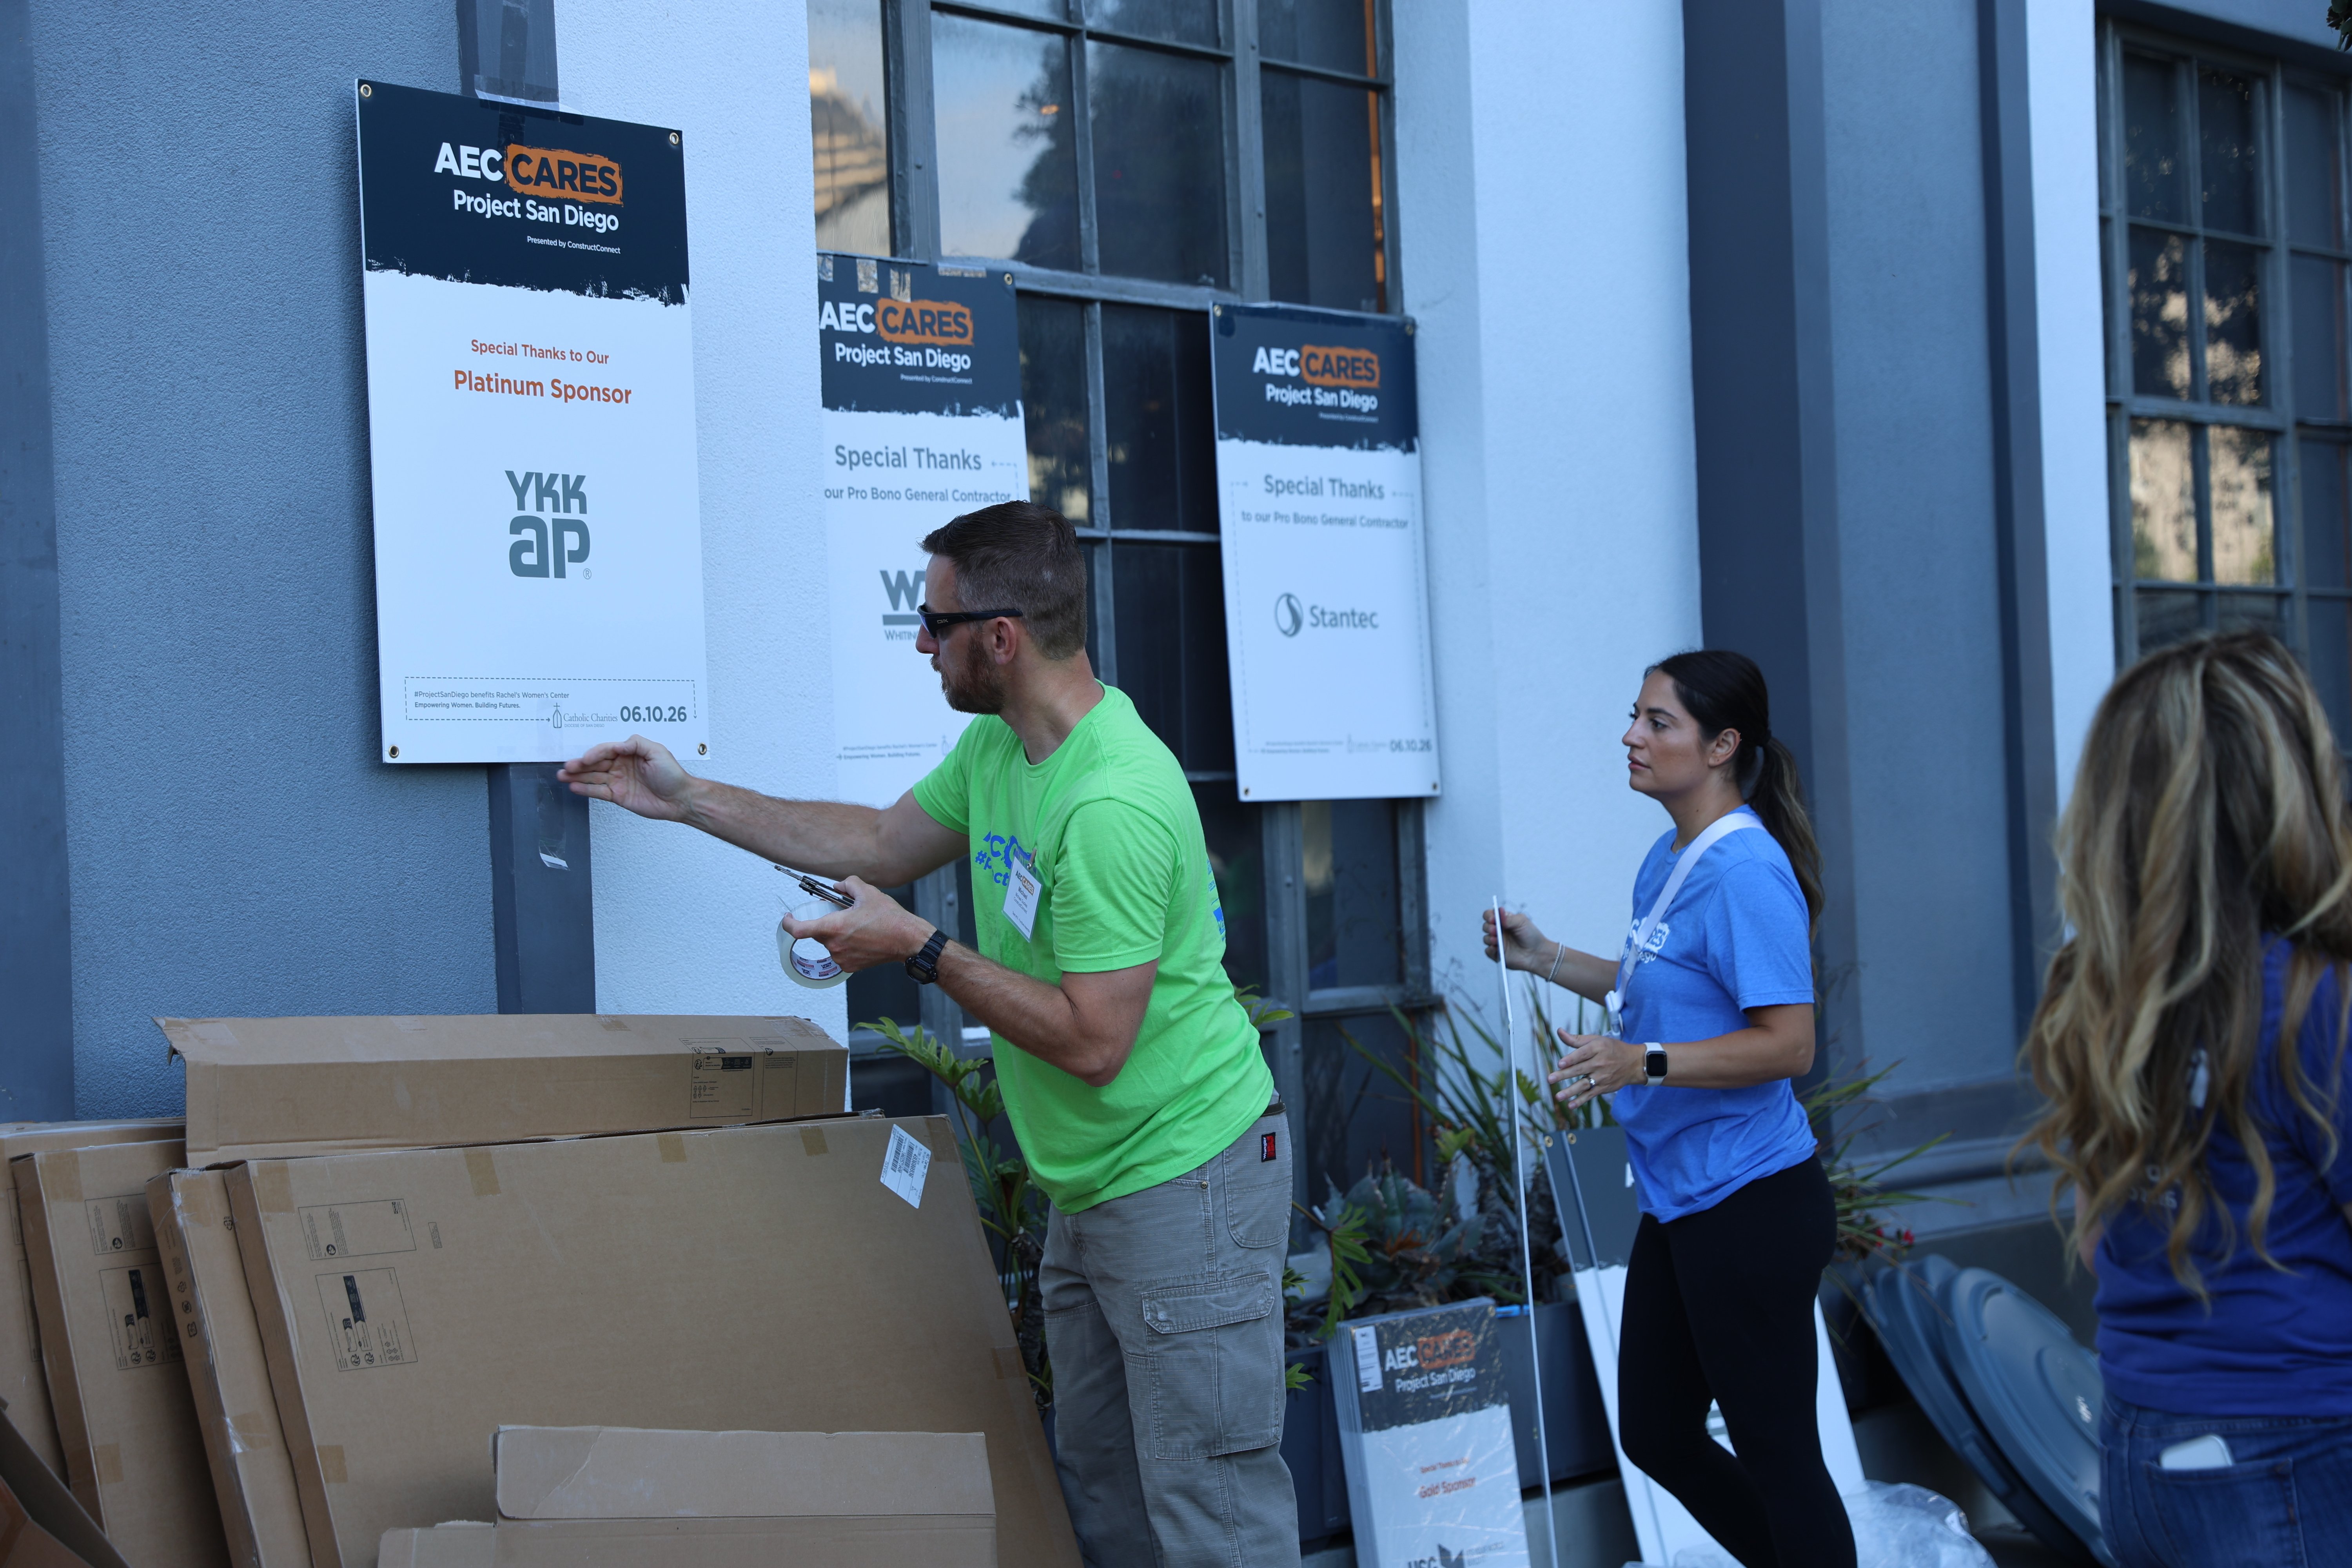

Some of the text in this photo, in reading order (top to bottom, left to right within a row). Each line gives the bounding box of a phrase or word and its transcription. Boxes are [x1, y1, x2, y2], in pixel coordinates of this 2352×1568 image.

[434, 142, 617, 197] AEC CARES
[454, 190, 619, 233] Project San Diego
[527, 236, 621, 254] Presented by ConstructConnect
[820, 301, 969, 338] AEC CARES
[471, 339, 609, 365] Special Thanks to Our
[835, 343, 971, 372] Project San Diego
[1253, 346, 1376, 381] AEC CARES
[454, 370, 632, 404] Platinum Sponsor
[1265, 383, 1378, 412] Project San Diego
[835, 445, 982, 470] Special Thanks
[505, 470, 588, 514] YKK
[824, 488, 1011, 503] our Pro Bono General Contractor
[1264, 475, 1384, 500] Special Thanks
[1241, 511, 1408, 529] to our Pro Bono General Contractor
[1310, 606, 1378, 629] Stantec
[414, 691, 469, 699] #ProjectSanDiego
[564, 713, 618, 722] Catholic Charities
[620, 706, 687, 722] 06.10.26
[1022, 879, 1034, 894] CARES
[1385, 1345, 1419, 1372] AEC
[1395, 1376, 1428, 1393] Project
[1430, 1372, 1448, 1386] San
[1449, 1367, 1476, 1383] Diego
